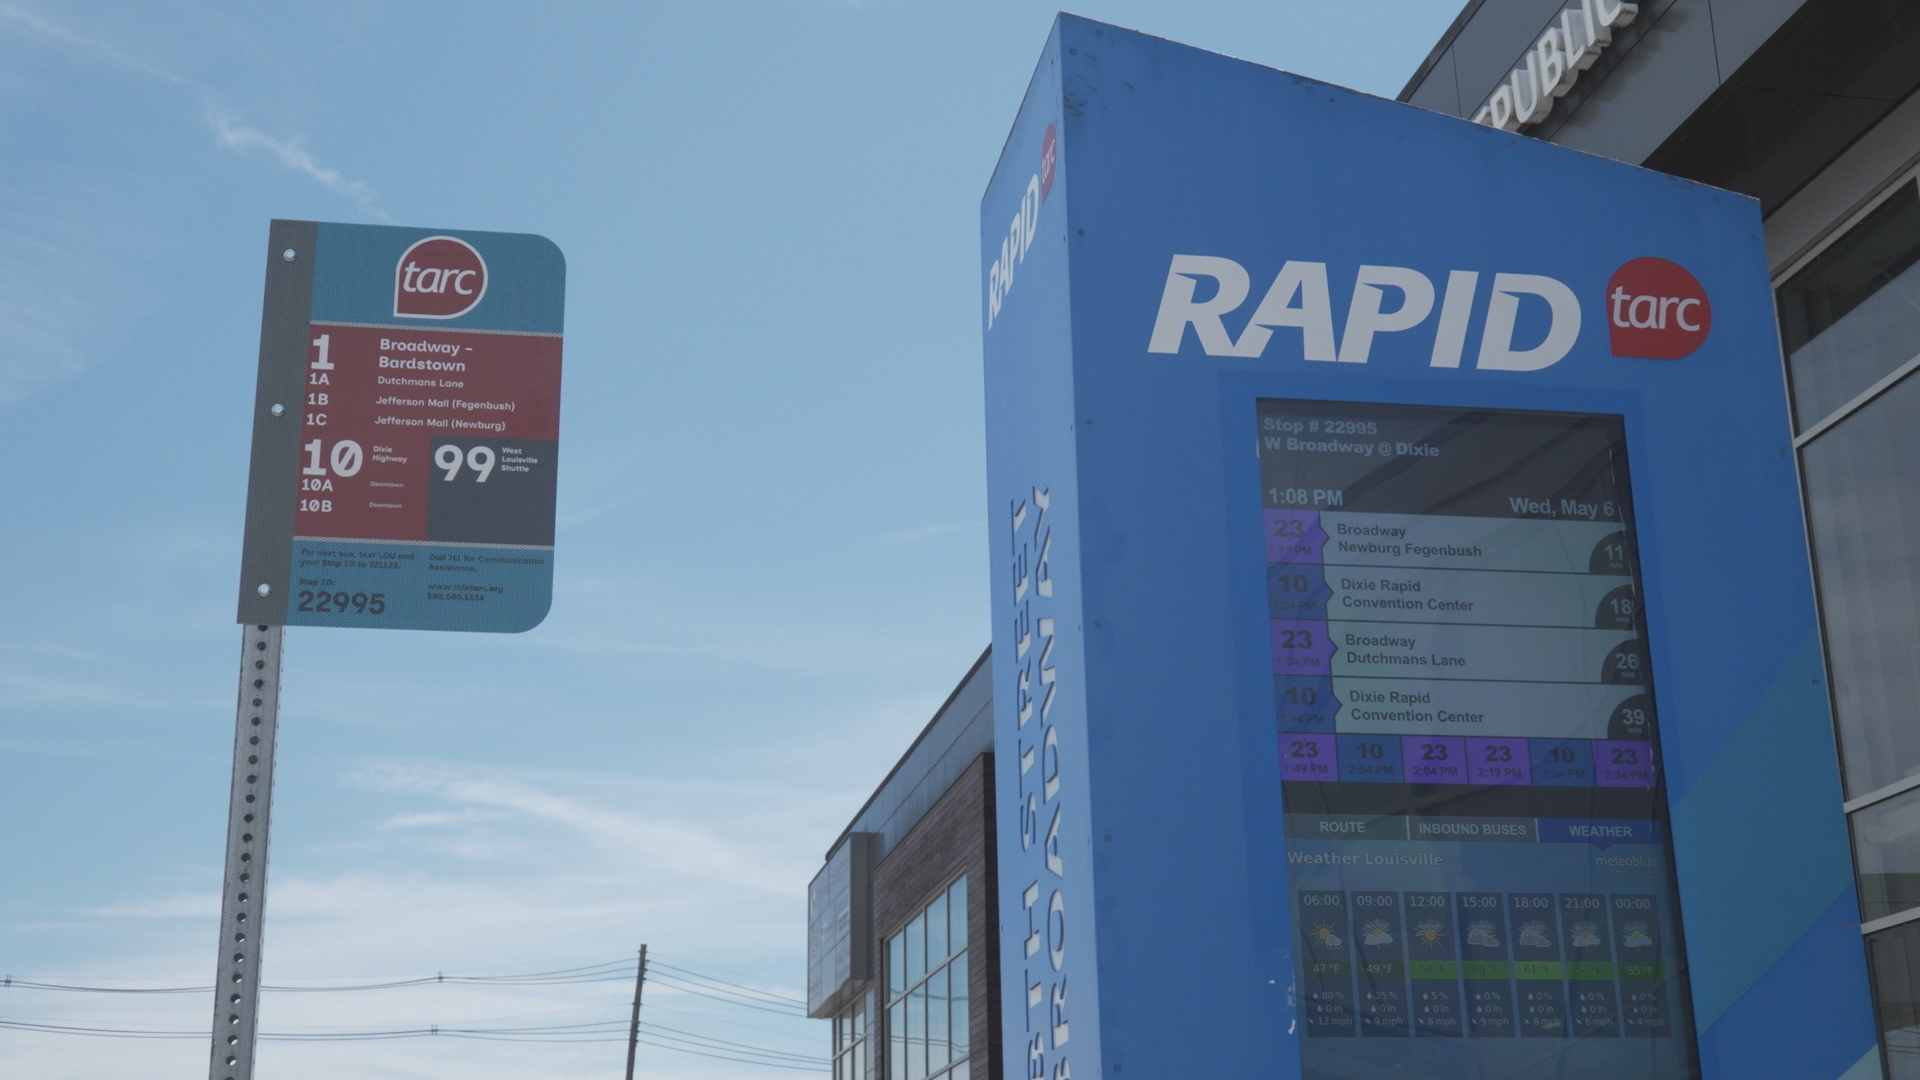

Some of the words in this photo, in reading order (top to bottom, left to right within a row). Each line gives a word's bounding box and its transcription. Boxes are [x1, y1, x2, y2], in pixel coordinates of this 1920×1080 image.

[1474, 0, 1638, 131] PUBLI
[1041, 138, 1055, 184] tarc
[988, 173, 1040, 331] RAPID
[402, 261, 476, 295] tarc
[1147, 254, 1582, 372] RAPID
[1611, 285, 1701, 332] tarc
[310, 334, 335, 371] 1
[379, 338, 460, 357] Broadway
[378, 356, 466, 372] Bardstown
[309, 373, 330, 386] 1A
[377, 375, 436, 388] Dutchmans
[439, 377, 464, 389] Lane
[307, 392, 329, 406] 1B
[375, 396, 425, 408] Jefferson
[427, 397, 449, 408] Mall
[451, 399, 516, 412] (Fegenbush)
[306, 412, 328, 426] 1C
[374, 415, 423, 427] Jefferson
[426, 417, 448, 428] Mall
[450, 418, 506, 432] (Newburg)
[1263, 417, 1304, 434] Stop
[1308, 419, 1320, 432] #
[1324, 420, 1378, 435] 22995
[373, 445, 393, 453] Dixie
[502, 446, 522, 455] West
[1264, 437, 1281, 450] W
[1286, 437, 1374, 457] Broadway
[1378, 441, 1391, 456] @
[1396, 441, 1440, 457] Dixie
[302, 439, 363, 477] 10
[372, 453, 408, 464] Highway
[434, 444, 496, 483] 99
[501, 455, 539, 465] Louisville
[501, 464, 530, 472] Shuttle
[301, 478, 333, 492] 10A
[370, 480, 404, 488] Downtown
[1269, 488, 1308, 504] 1:08
[1313, 489, 1344, 506] PM
[300, 499, 333, 513] 10B
[369, 501, 403, 509] Downtown
[1509, 497, 1557, 517] Wed,
[1560, 498, 1599, 521] May
[1603, 501, 1615, 517] 6
[1273, 519, 1305, 538] 23
[1337, 523, 1407, 540] Broadway
[301, 548, 314, 556] For
[1297, 545, 1313, 556] PM
[1338, 541, 1402, 557] Newburg
[1404, 543, 1482, 558] Fegenbush
[1604, 544, 1624, 561] 11
[321, 559, 342, 568] Stop
[429, 553, 446, 561] Dial
[478, 555, 545, 565] Communication
[1608, 561, 1623, 569] min
[299, 578, 319, 586] Stop
[1278, 574, 1308, 593] 10
[1341, 578, 1376, 591] Dixie
[1380, 579, 1421, 594] Rapid
[298, 589, 386, 615] 22995
[1299, 601, 1317, 610] PM
[1342, 596, 1423, 610] Convention
[1427, 598, 1474, 611] Center
[1610, 598, 1632, 615] 18
[1281, 630, 1313, 649] 23
[1345, 634, 1416, 650] Broadway
[1303, 657, 1320, 667] PM
[1346, 652, 1427, 666] Dutchmans
[1431, 654, 1466, 667] Lane
[1615, 653, 1639, 670] 26
[1011, 498, 1037, 853] STREET
[1621, 670, 1636, 678] min
[1286, 686, 1317, 706] 10
[1349, 690, 1385, 703] Dixie
[1389, 691, 1431, 706] Rapid
[1306, 714, 1325, 724] PM
[1351, 708, 1433, 723] Convention
[1437, 710, 1484, 724] Center
[1622, 708, 1645, 725] 39
[1627, 726, 1642, 734] min
[1291, 741, 1319, 758] 23
[1357, 742, 1384, 759] 10
[1420, 744, 1448, 761] 23
[1485, 745, 1512, 762] 23
[1549, 747, 1575, 763] 10
[1611, 748, 1638, 765] 23
[1283, 764, 1307, 773] 1:49
[1310, 764, 1328, 773] PM
[1348, 765, 1372, 774] 2:04
[1376, 765, 1393, 775] PM
[1413, 766, 1437, 776] 2:04
[1440, 766, 1458, 776] PM
[1477, 767, 1501, 777] 2:19
[1504, 768, 1522, 778] PM
[1541, 768, 1565, 778] 2:24
[1568, 769, 1585, 779] PM
[1605, 770, 1628, 779] 2:34
[1631, 770, 1648, 780] PM
[1319, 821, 1366, 833] ROUTE
[1419, 823, 1479, 835] INBOUND
[1482, 824, 1527, 836] BUSES
[1568, 825, 1633, 837] WEATHER
[1287, 851, 1359, 865] Weather
[1365, 852, 1444, 866] Louisville
[1596, 855, 1658, 867] meteoblue
[1303, 894, 1340, 906] 06:00
[1357, 895, 1393, 907] 09:00
[1410, 896, 1445, 907] 12:00
[1462, 896, 1497, 908] 15:00
[1514, 897, 1548, 908] 18:00
[1565, 898, 1599, 909] 21:00
[1616, 898, 1650, 909] 00:00
[1313, 964, 1327, 973] 47
[1366, 964, 1380, 973] 49
[1524, 965, 1537, 975] 61
[1627, 966, 1641, 975] 55
[1331, 1017, 1353, 1027] mph
